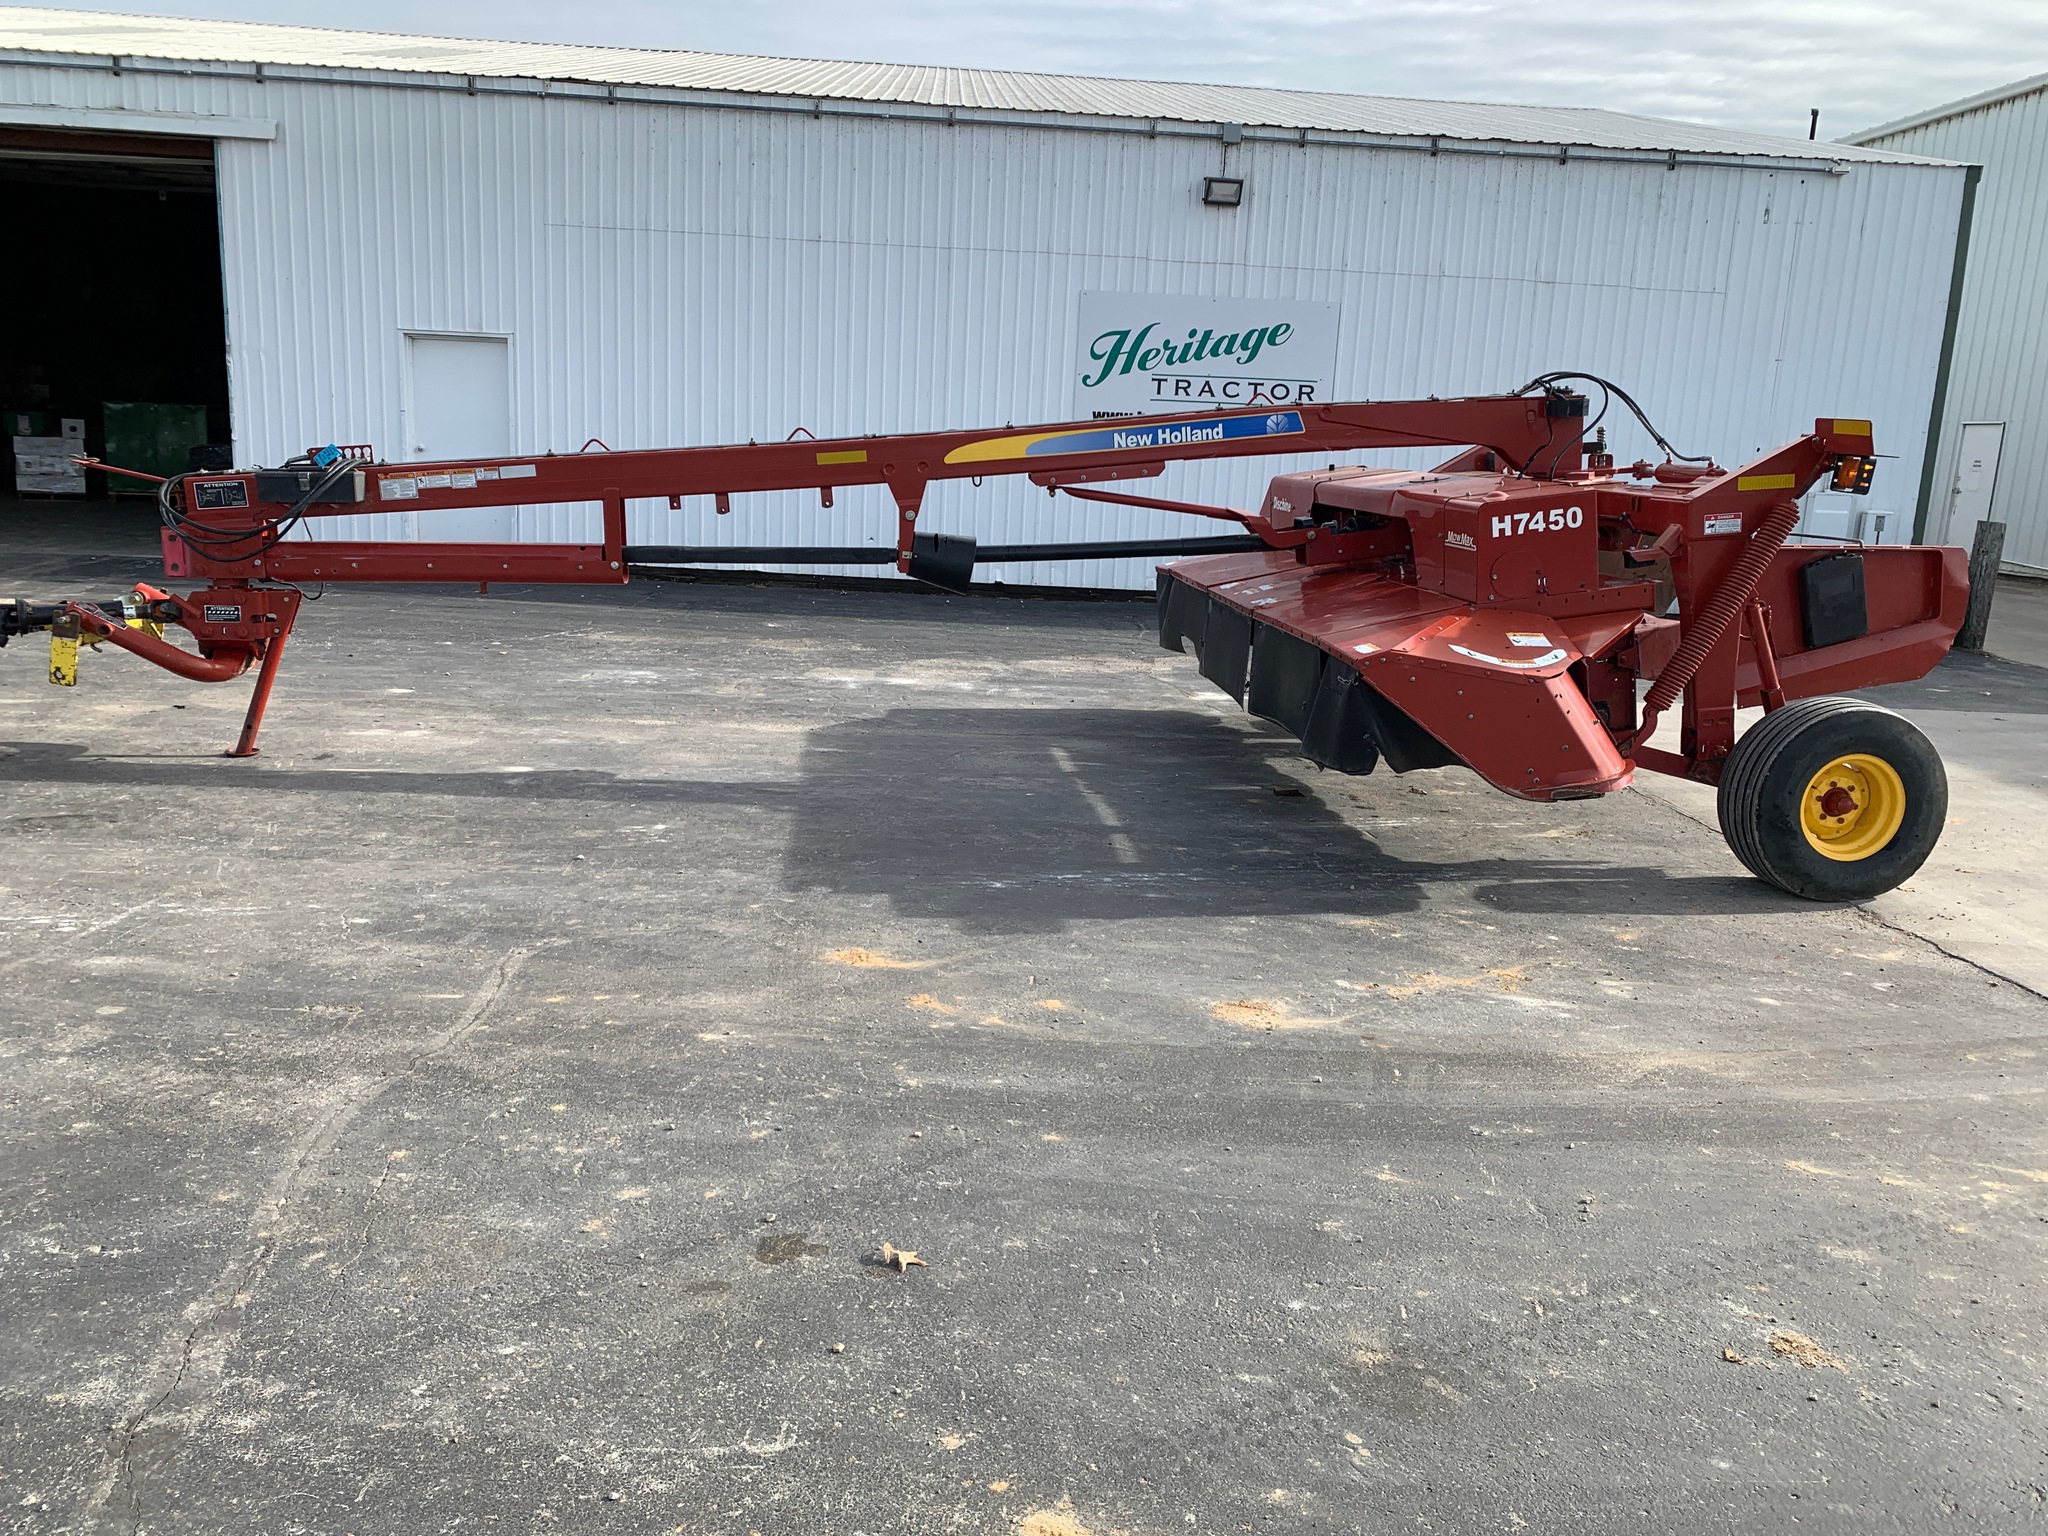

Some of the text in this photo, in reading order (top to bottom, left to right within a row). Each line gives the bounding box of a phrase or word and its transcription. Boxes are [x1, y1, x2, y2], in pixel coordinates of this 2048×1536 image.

[1082, 322, 1295, 387] Heritage
[1151, 377, 1316, 402] TRACTOR
[1113, 423, 1223, 449] New Holland
[1491, 506, 1583, 538] H7450
